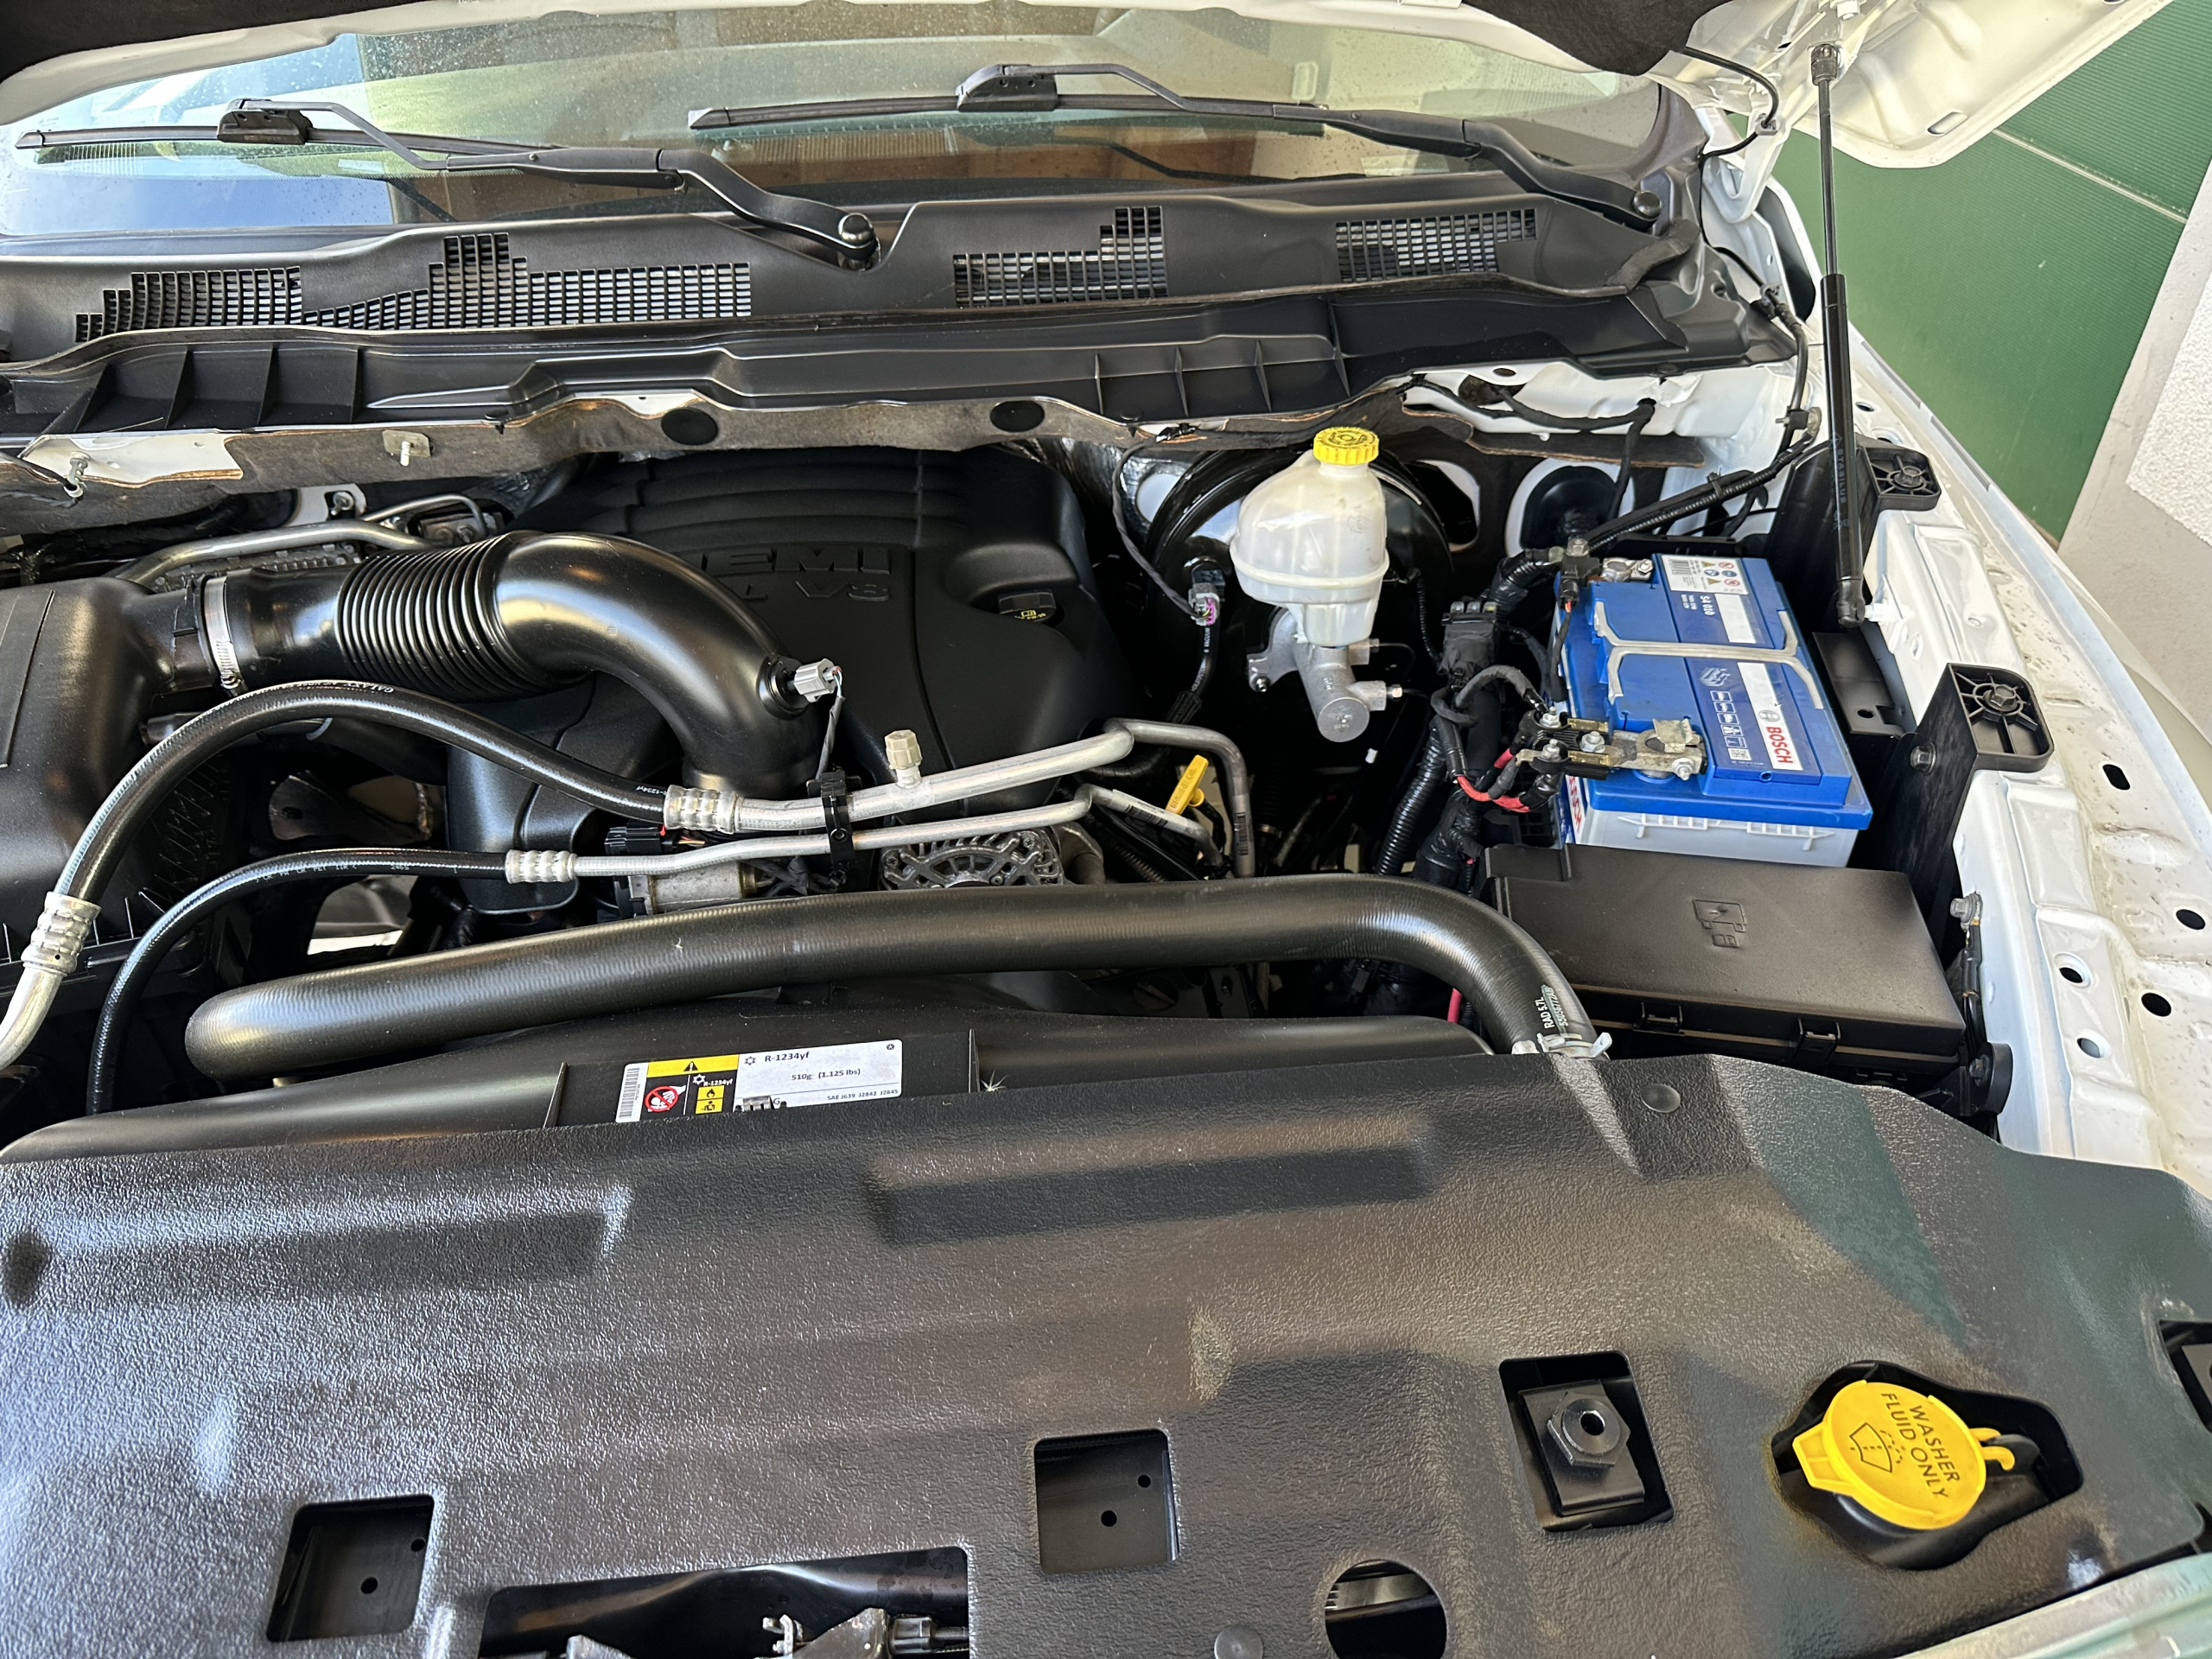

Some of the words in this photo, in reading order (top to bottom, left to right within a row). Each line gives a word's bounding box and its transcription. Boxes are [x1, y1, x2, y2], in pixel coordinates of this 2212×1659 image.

[1838, 448, 1847, 503] STABILUS
[1700, 595, 1712, 604] S4
[1766, 727, 1794, 764] BOSCH
[1535, 996, 1548, 1012] 5.7L
[1540, 1011, 1555, 1029] RAD
[765, 1051, 810, 1063] R-1234yf
[818, 1069, 844, 1079] (1.125
[845, 1068, 861, 1077] lbs)
[703, 1078, 734, 1087] R-1234yf
[1880, 1392, 1918, 1441] FLUID
[1910, 1446, 1949, 1498] ONLY
[1909, 1404, 1961, 1482] WASHER
